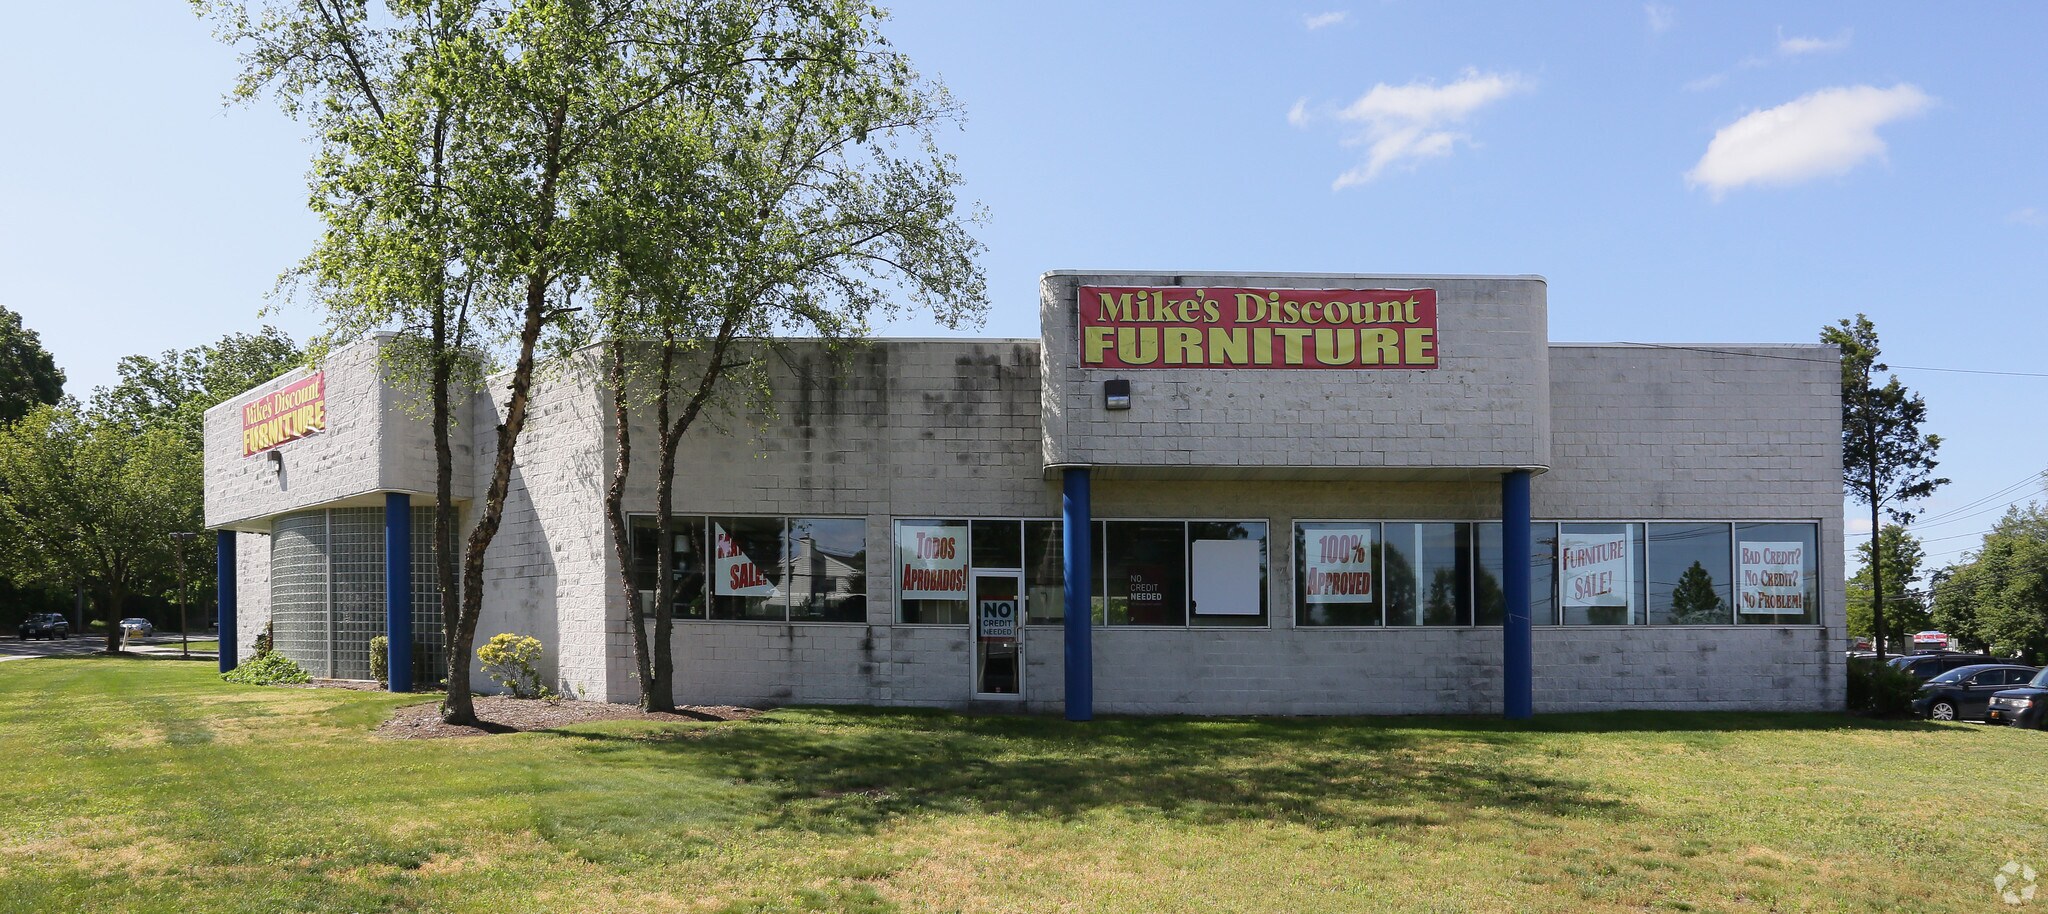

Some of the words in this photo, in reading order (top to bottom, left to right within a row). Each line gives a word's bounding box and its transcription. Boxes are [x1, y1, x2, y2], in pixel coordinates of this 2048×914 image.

[1097, 289, 1220, 323] Mike's
[1235, 291, 1421, 324] Discount
[1084, 326, 1436, 365] FURNITURE
[245, 397, 272, 426] Mike's
[275, 380, 320, 415] Discount
[243, 400, 325, 455] FURNITURE
[1319, 535, 1365, 563] 100%
[1563, 540, 1624, 570] FURNITURE
[1130, 593, 1162, 601] NEEDED
[1575, 571, 1612, 600] SALE!
[984, 602, 1011, 618] NO
